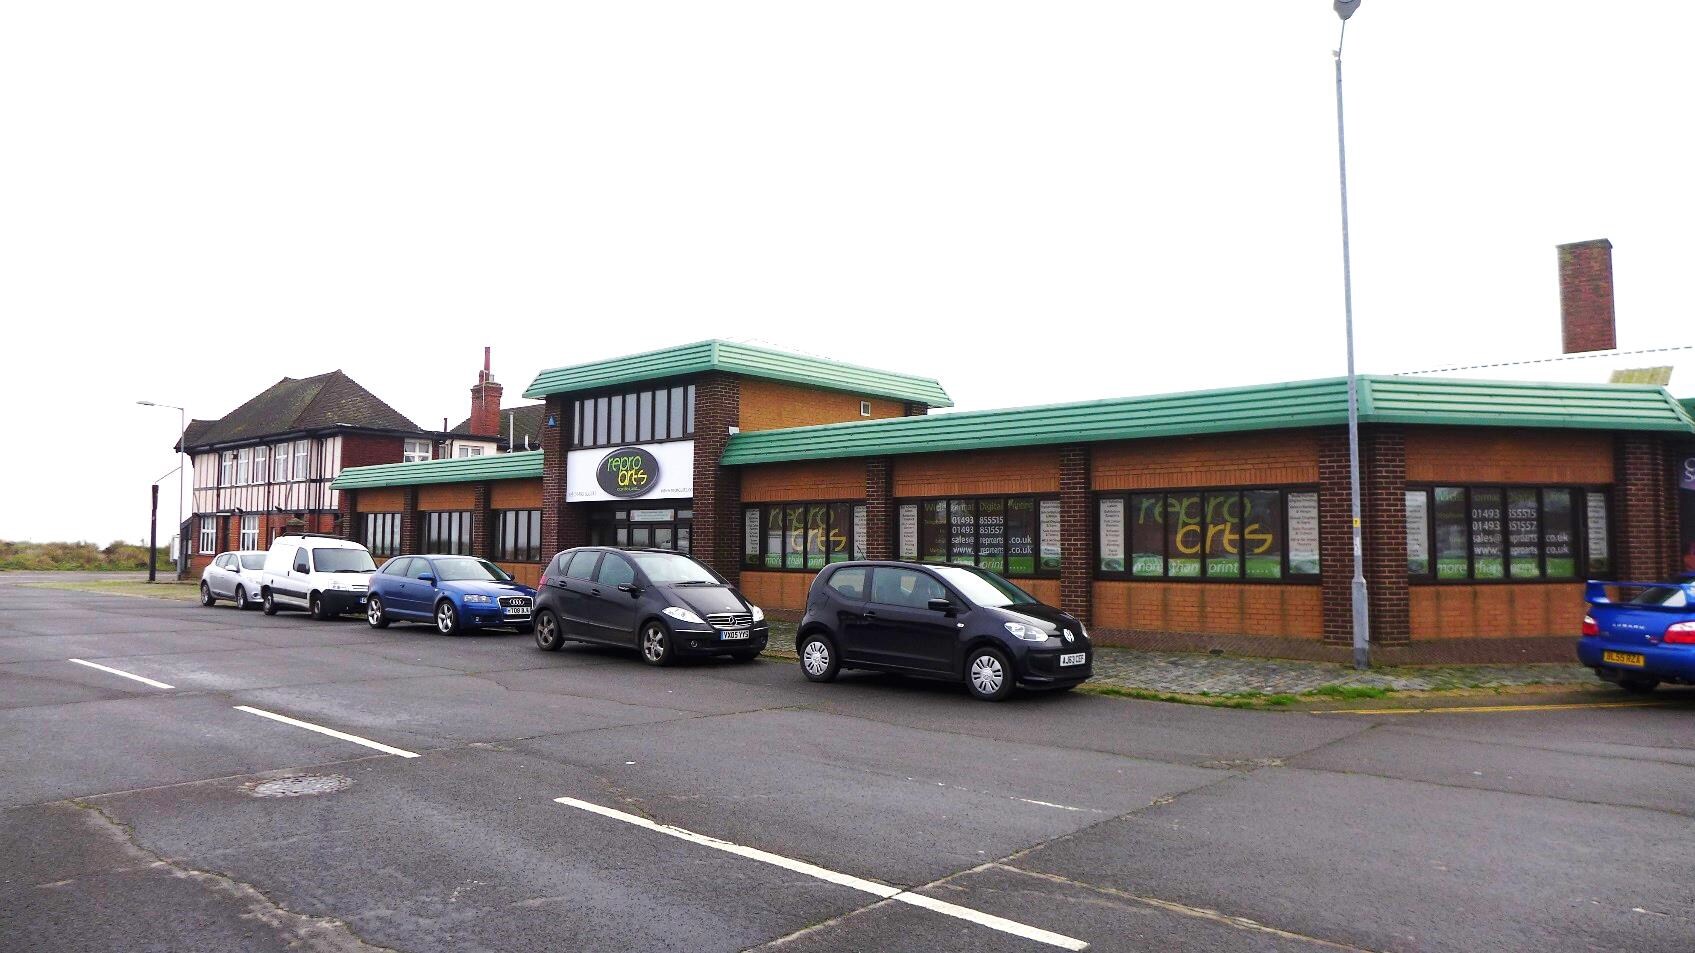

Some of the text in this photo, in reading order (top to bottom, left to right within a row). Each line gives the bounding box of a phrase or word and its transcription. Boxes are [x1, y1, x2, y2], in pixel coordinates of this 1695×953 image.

[607, 455, 642, 472] repro
[618, 468, 648, 486] arts
[1472, 508, 1500, 519] 01493
[951, 516, 974, 525] 01493
[1472, 521, 1500, 530] 01493
[951, 526, 974, 535] 01493
[1208, 561, 1239, 574] print
